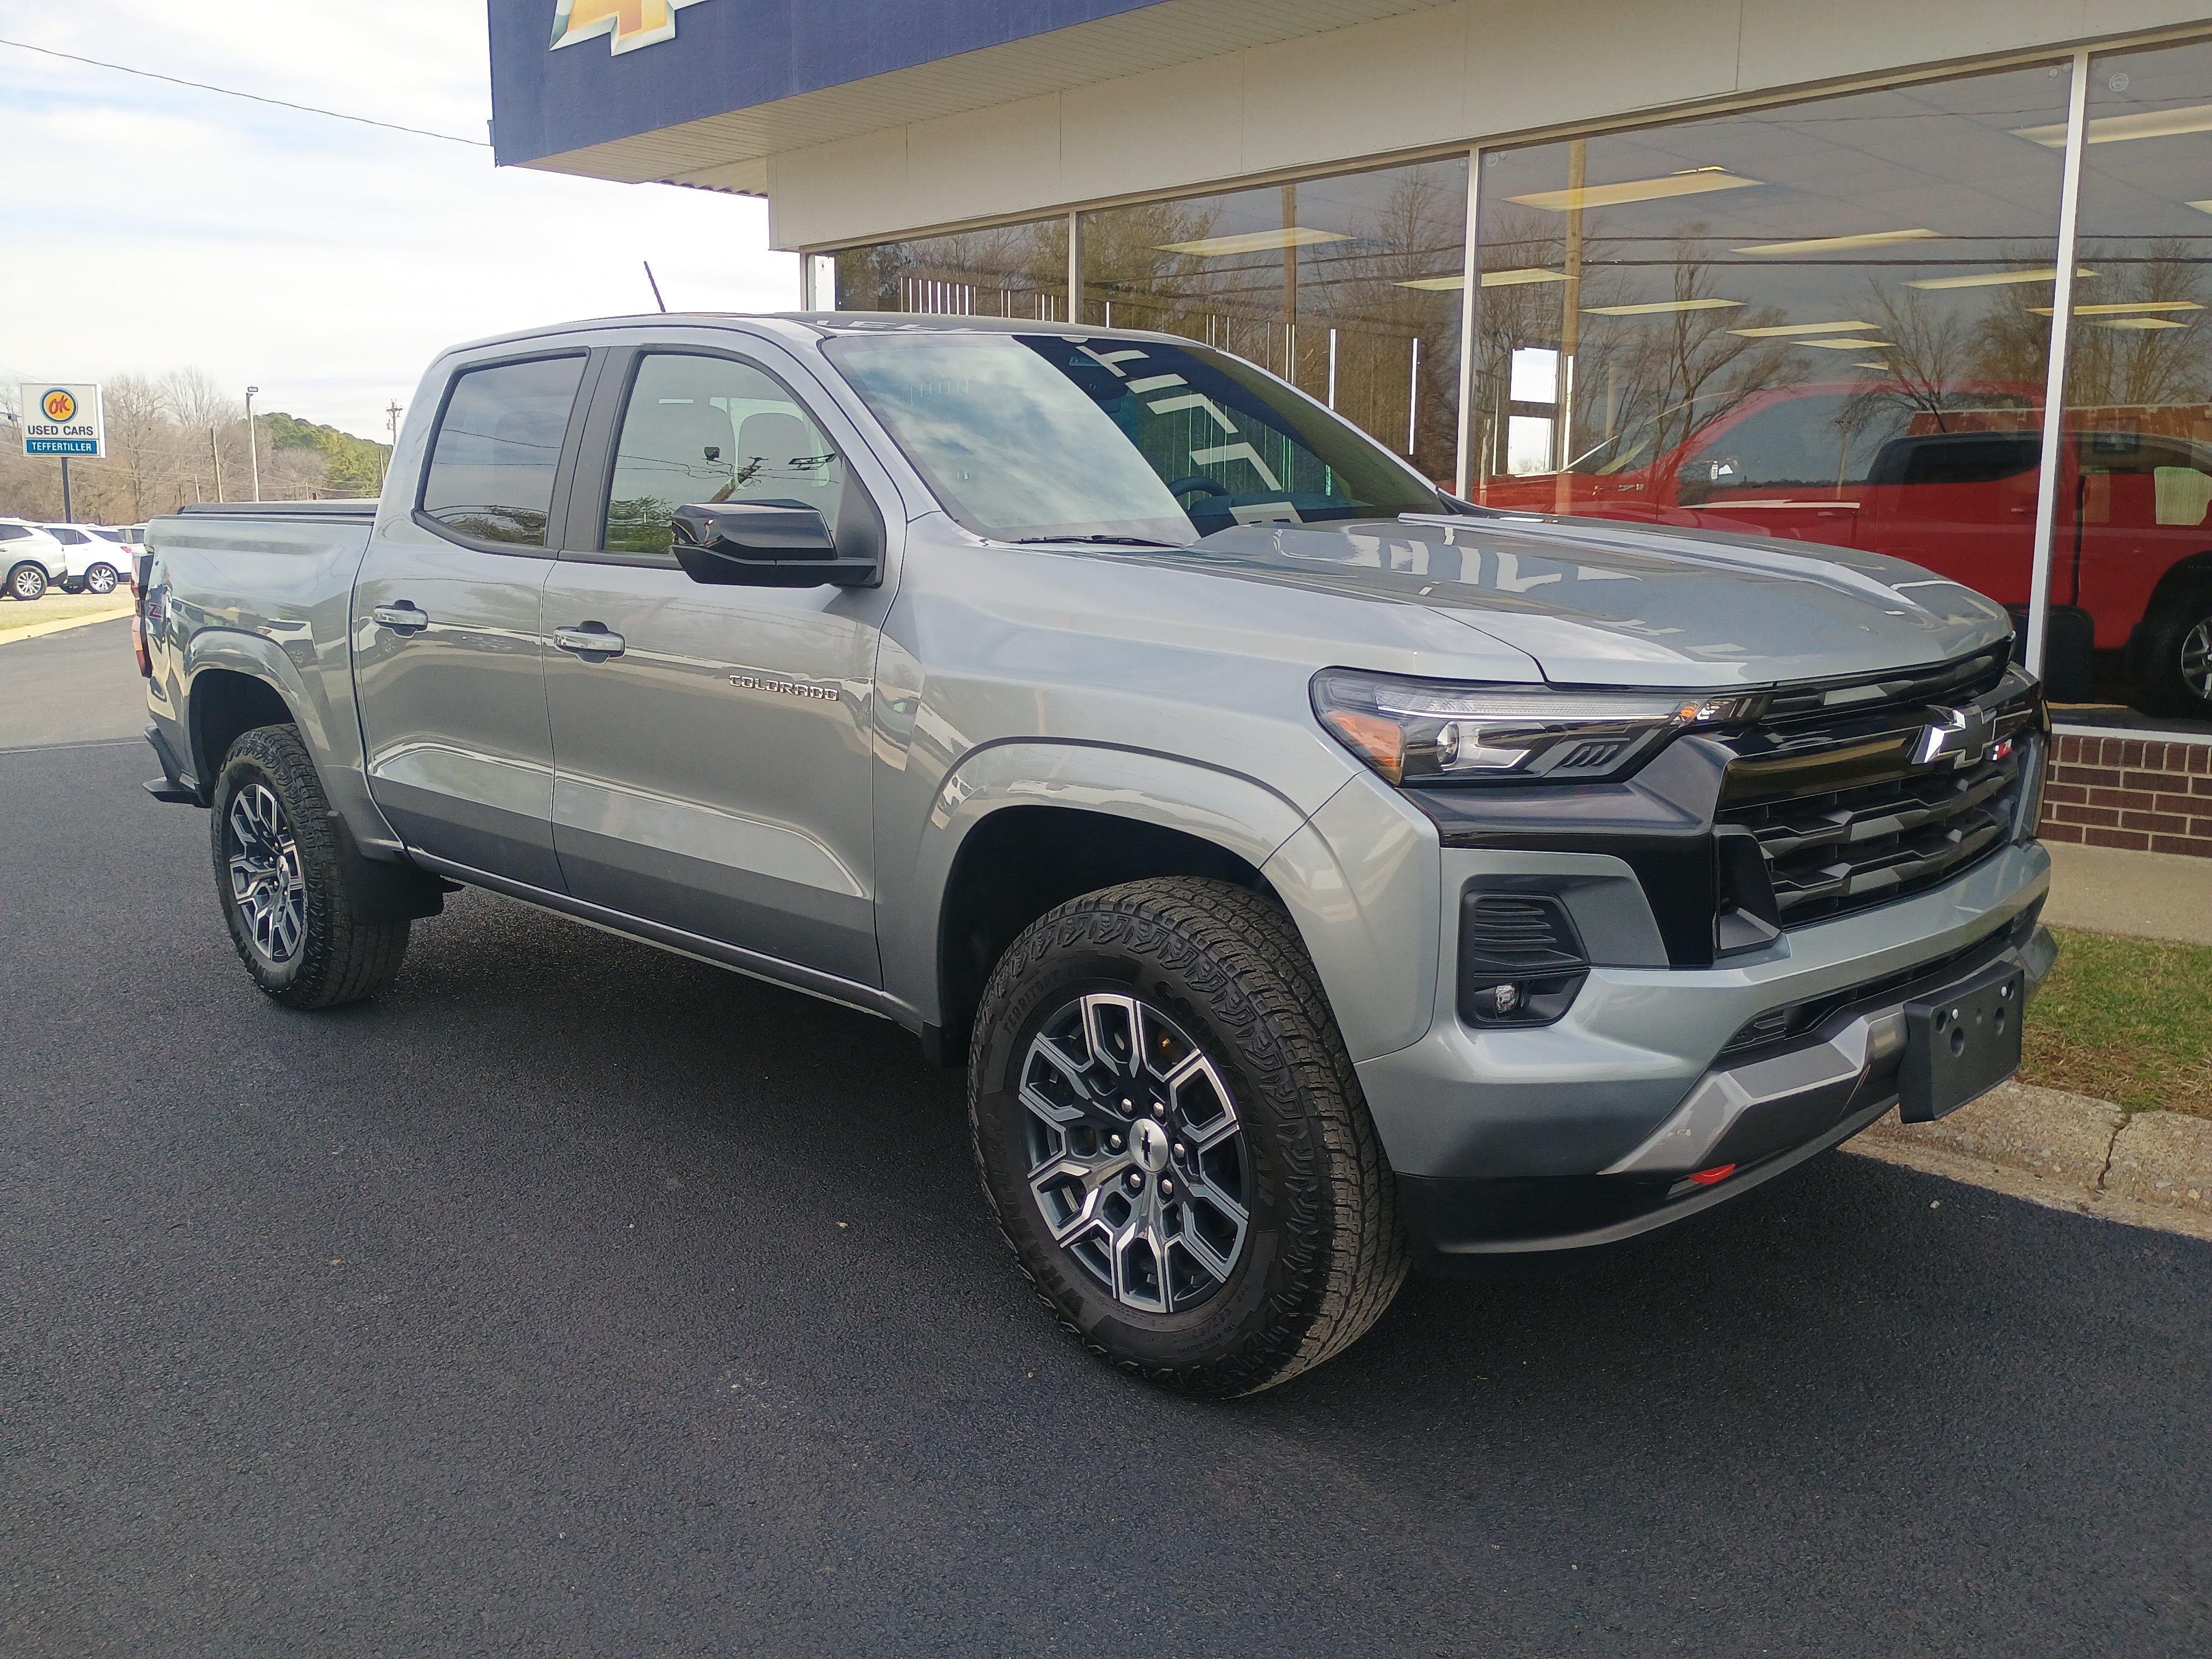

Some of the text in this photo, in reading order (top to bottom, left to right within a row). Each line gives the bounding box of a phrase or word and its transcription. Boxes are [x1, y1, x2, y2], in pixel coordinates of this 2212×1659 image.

[49, 395, 70, 414] OK
[28, 425, 93, 436] USED CARS
[31, 442, 92, 451] TEFFERTILLER
[729, 675, 839, 702] COLORADO
